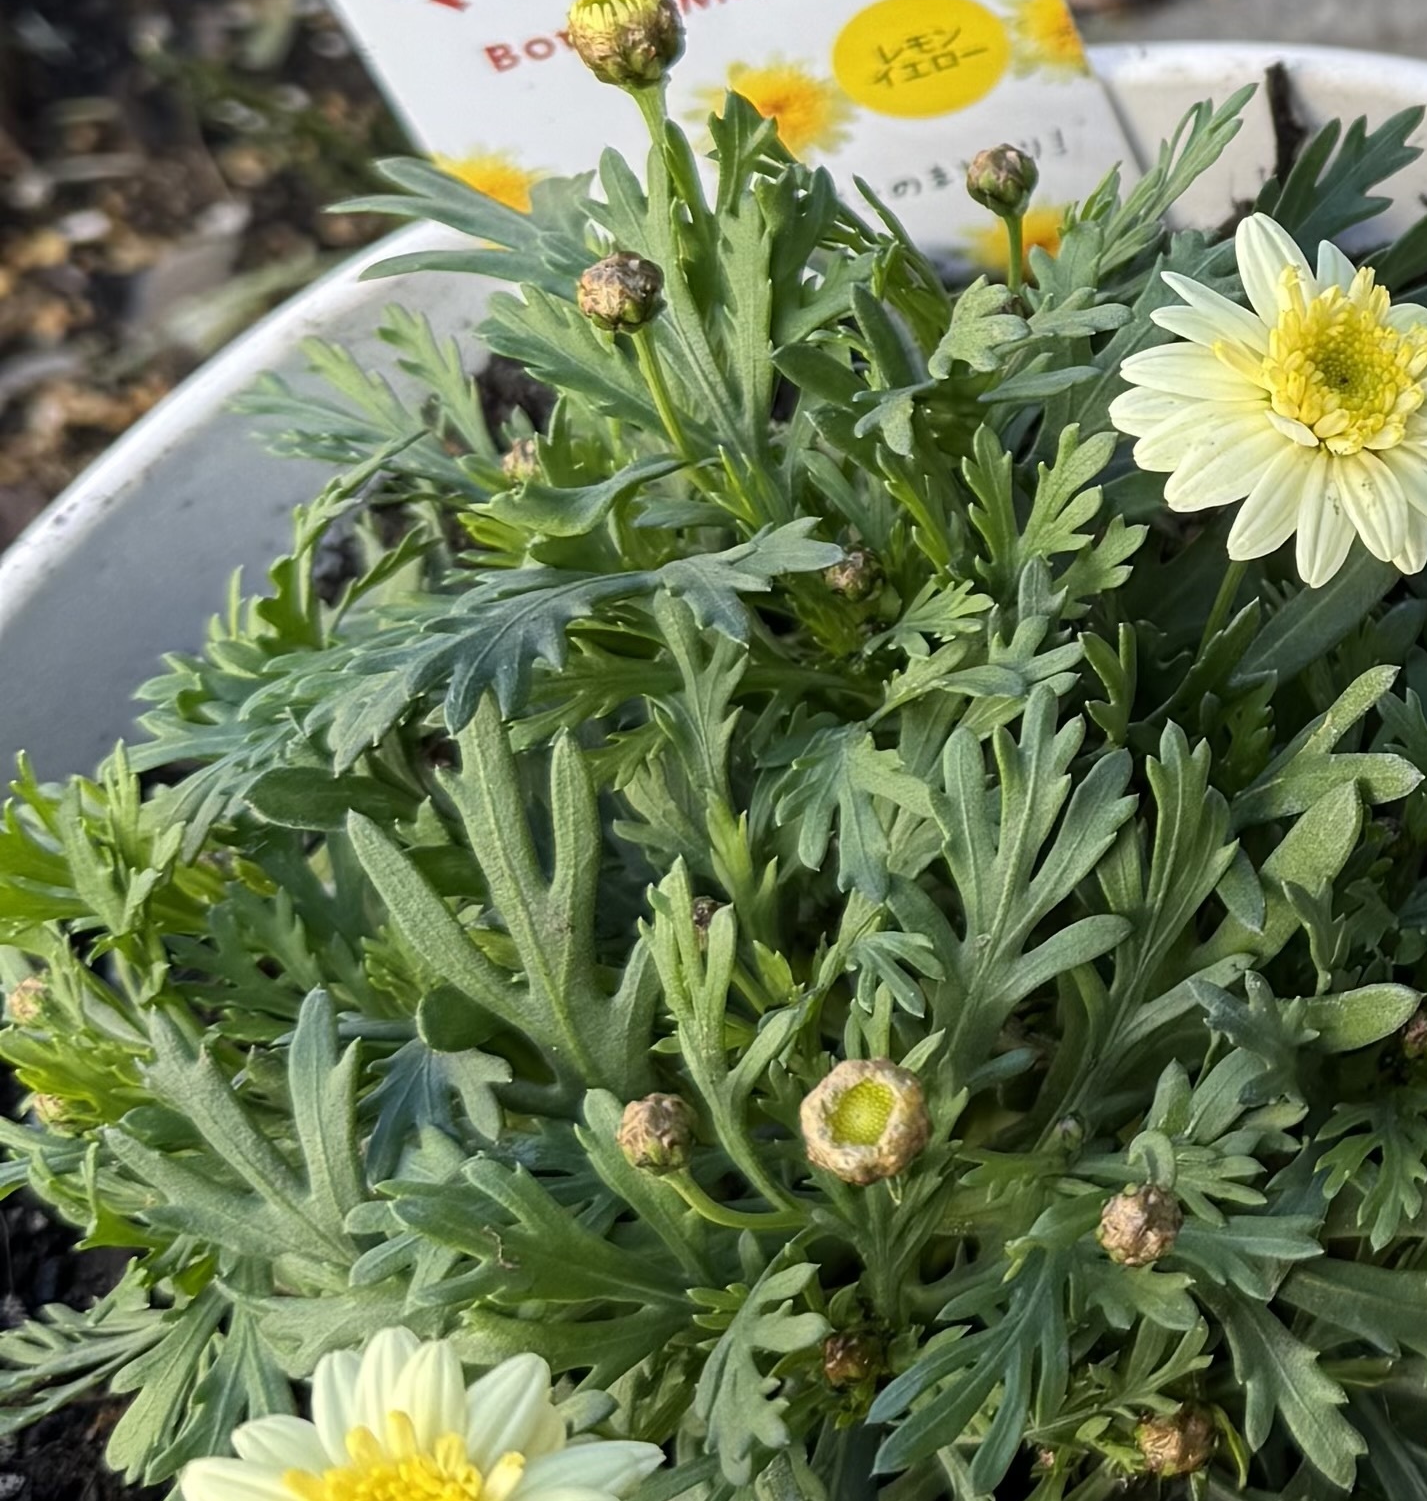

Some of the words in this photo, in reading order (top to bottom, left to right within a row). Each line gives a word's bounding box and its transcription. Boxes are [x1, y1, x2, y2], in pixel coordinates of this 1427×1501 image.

[876, 26, 962, 66] レモン
[870, 47, 990, 89] イエロー
